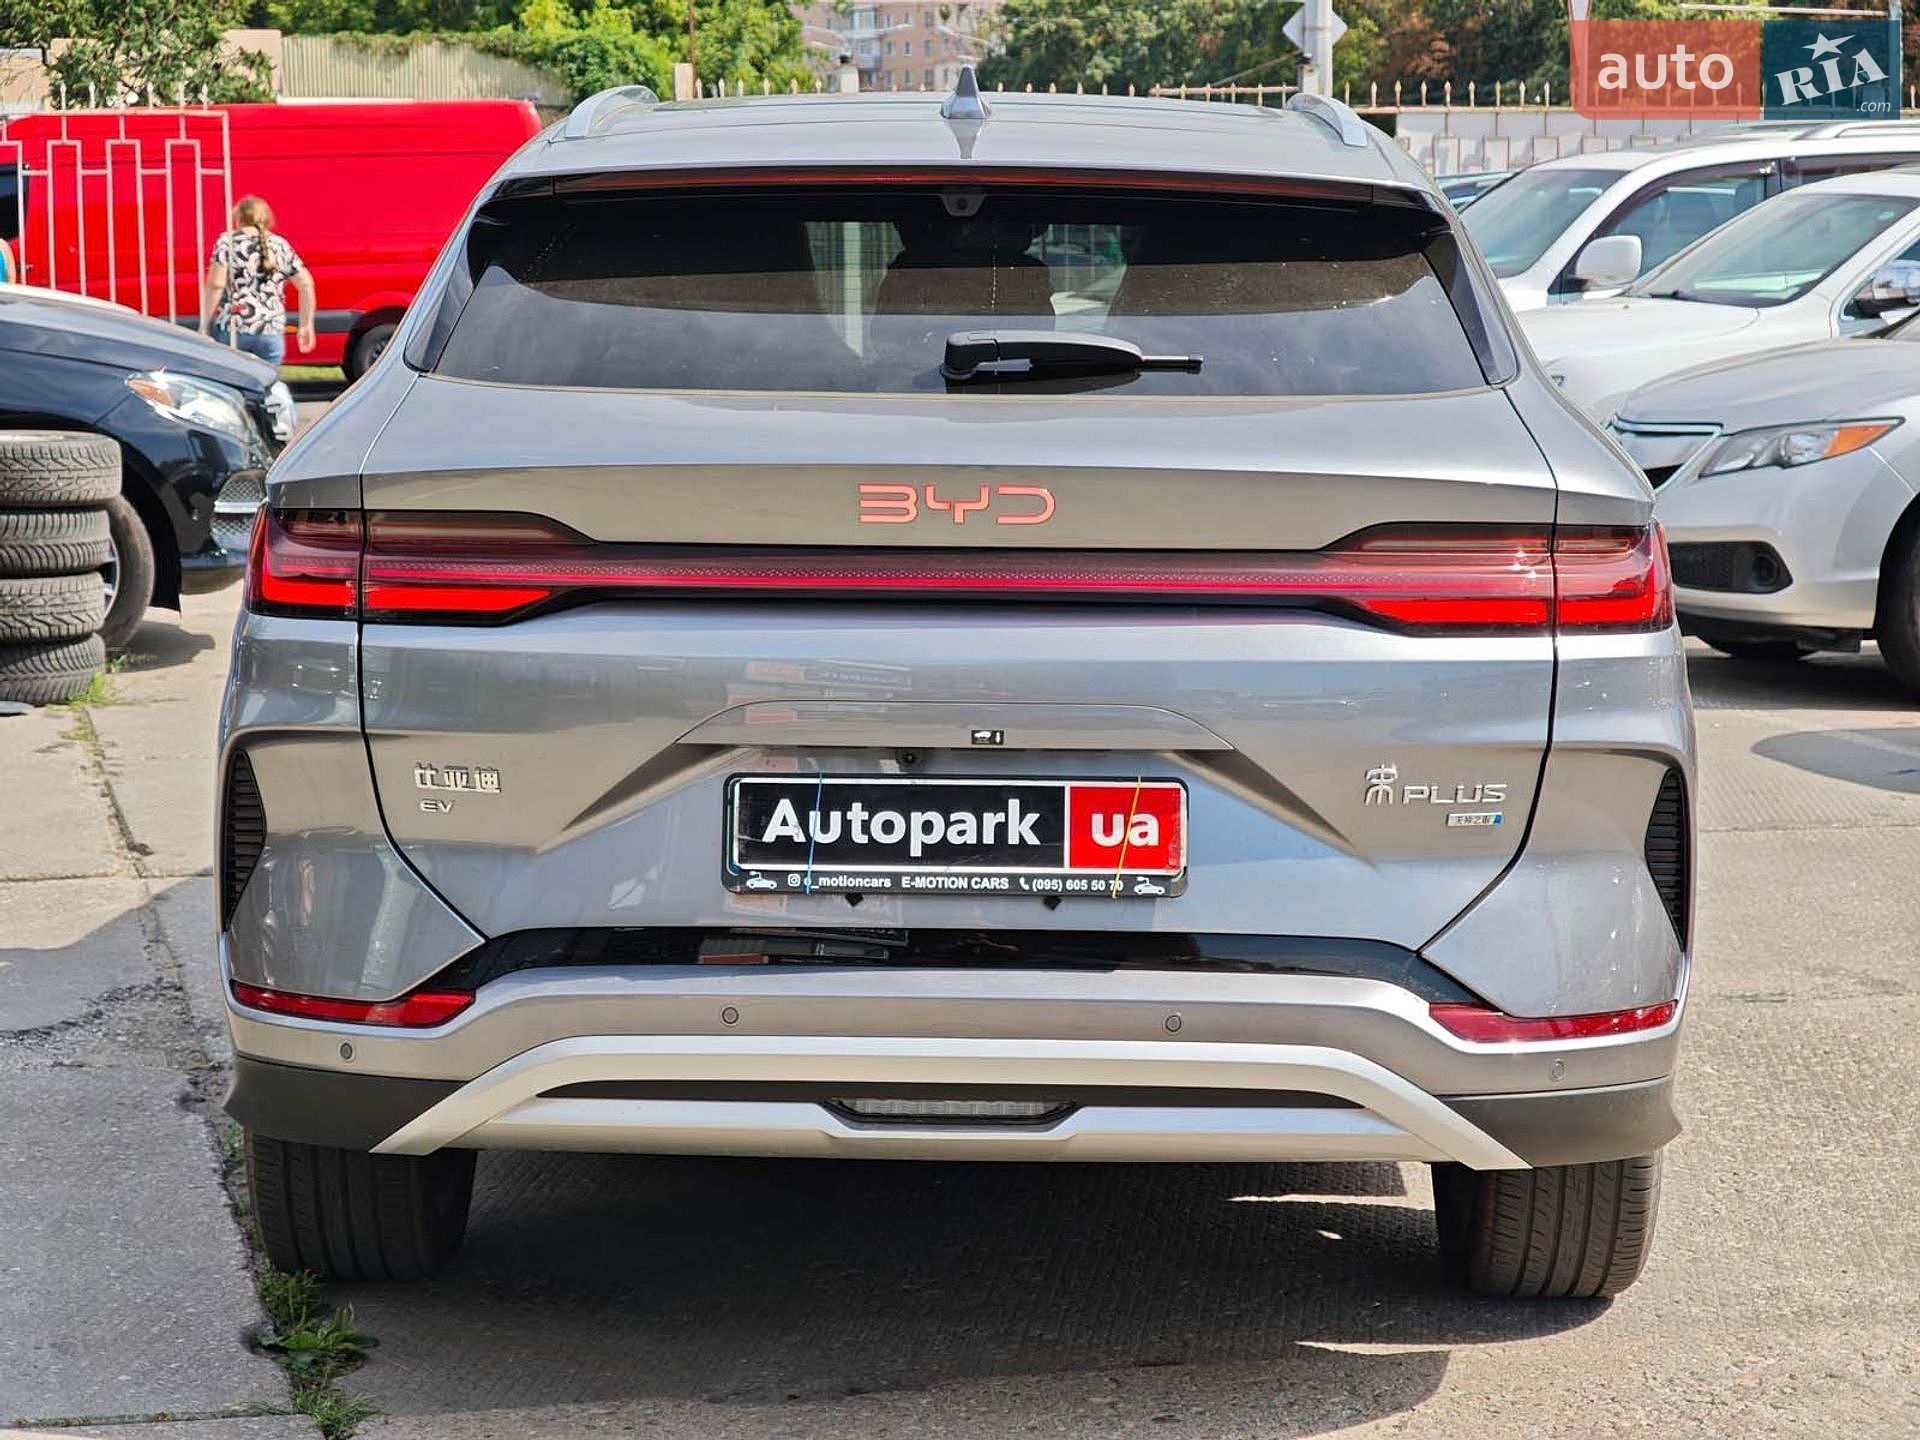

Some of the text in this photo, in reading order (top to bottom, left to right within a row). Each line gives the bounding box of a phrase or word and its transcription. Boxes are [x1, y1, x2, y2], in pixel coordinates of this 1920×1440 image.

[858, 483, 1055, 524] BYD
[1402, 783, 1508, 805] PLUS
[419, 799, 455, 814] EV
[762, 798, 1160, 857] Autopark ua
[901, 876, 1009, 890] E-MOTION CARS
[1032, 879, 1063, 892] (095)
[1065, 879, 1088, 891] 605
[1090, 879, 1106, 891] 50
